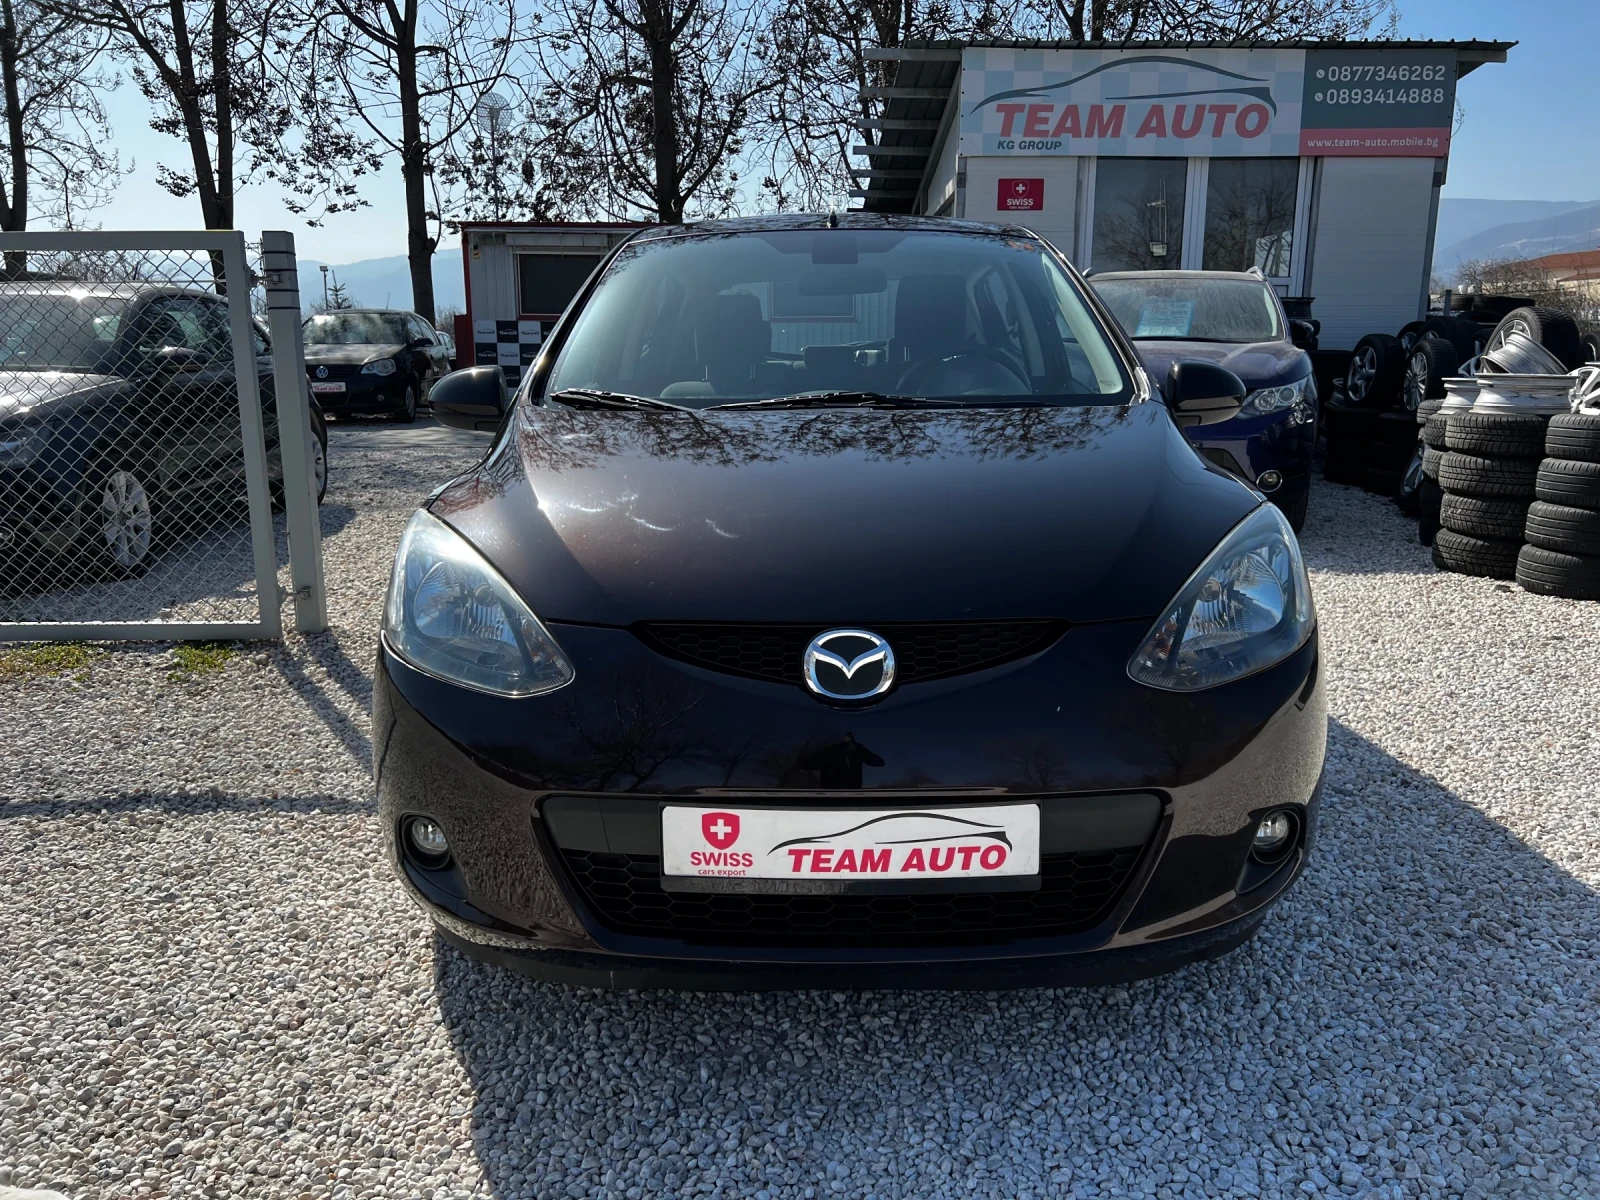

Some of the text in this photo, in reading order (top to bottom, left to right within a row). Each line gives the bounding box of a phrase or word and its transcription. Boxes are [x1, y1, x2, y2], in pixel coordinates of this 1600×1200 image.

[1328, 65, 1446, 82] 0877346262
[1326, 88, 1445, 105] 0893414888
[995, 103, 1270, 139] TEAM AUTO
[997, 140, 1062, 150] KG GROUP
[1307, 137, 1439, 148] www.team-auto.mobile.bg
[1006, 198, 1034, 206] SWISS
[690, 851, 753, 868] SWISS
[787, 844, 1007, 873] TEAM AUTO
[698, 868, 746, 878] cars export
